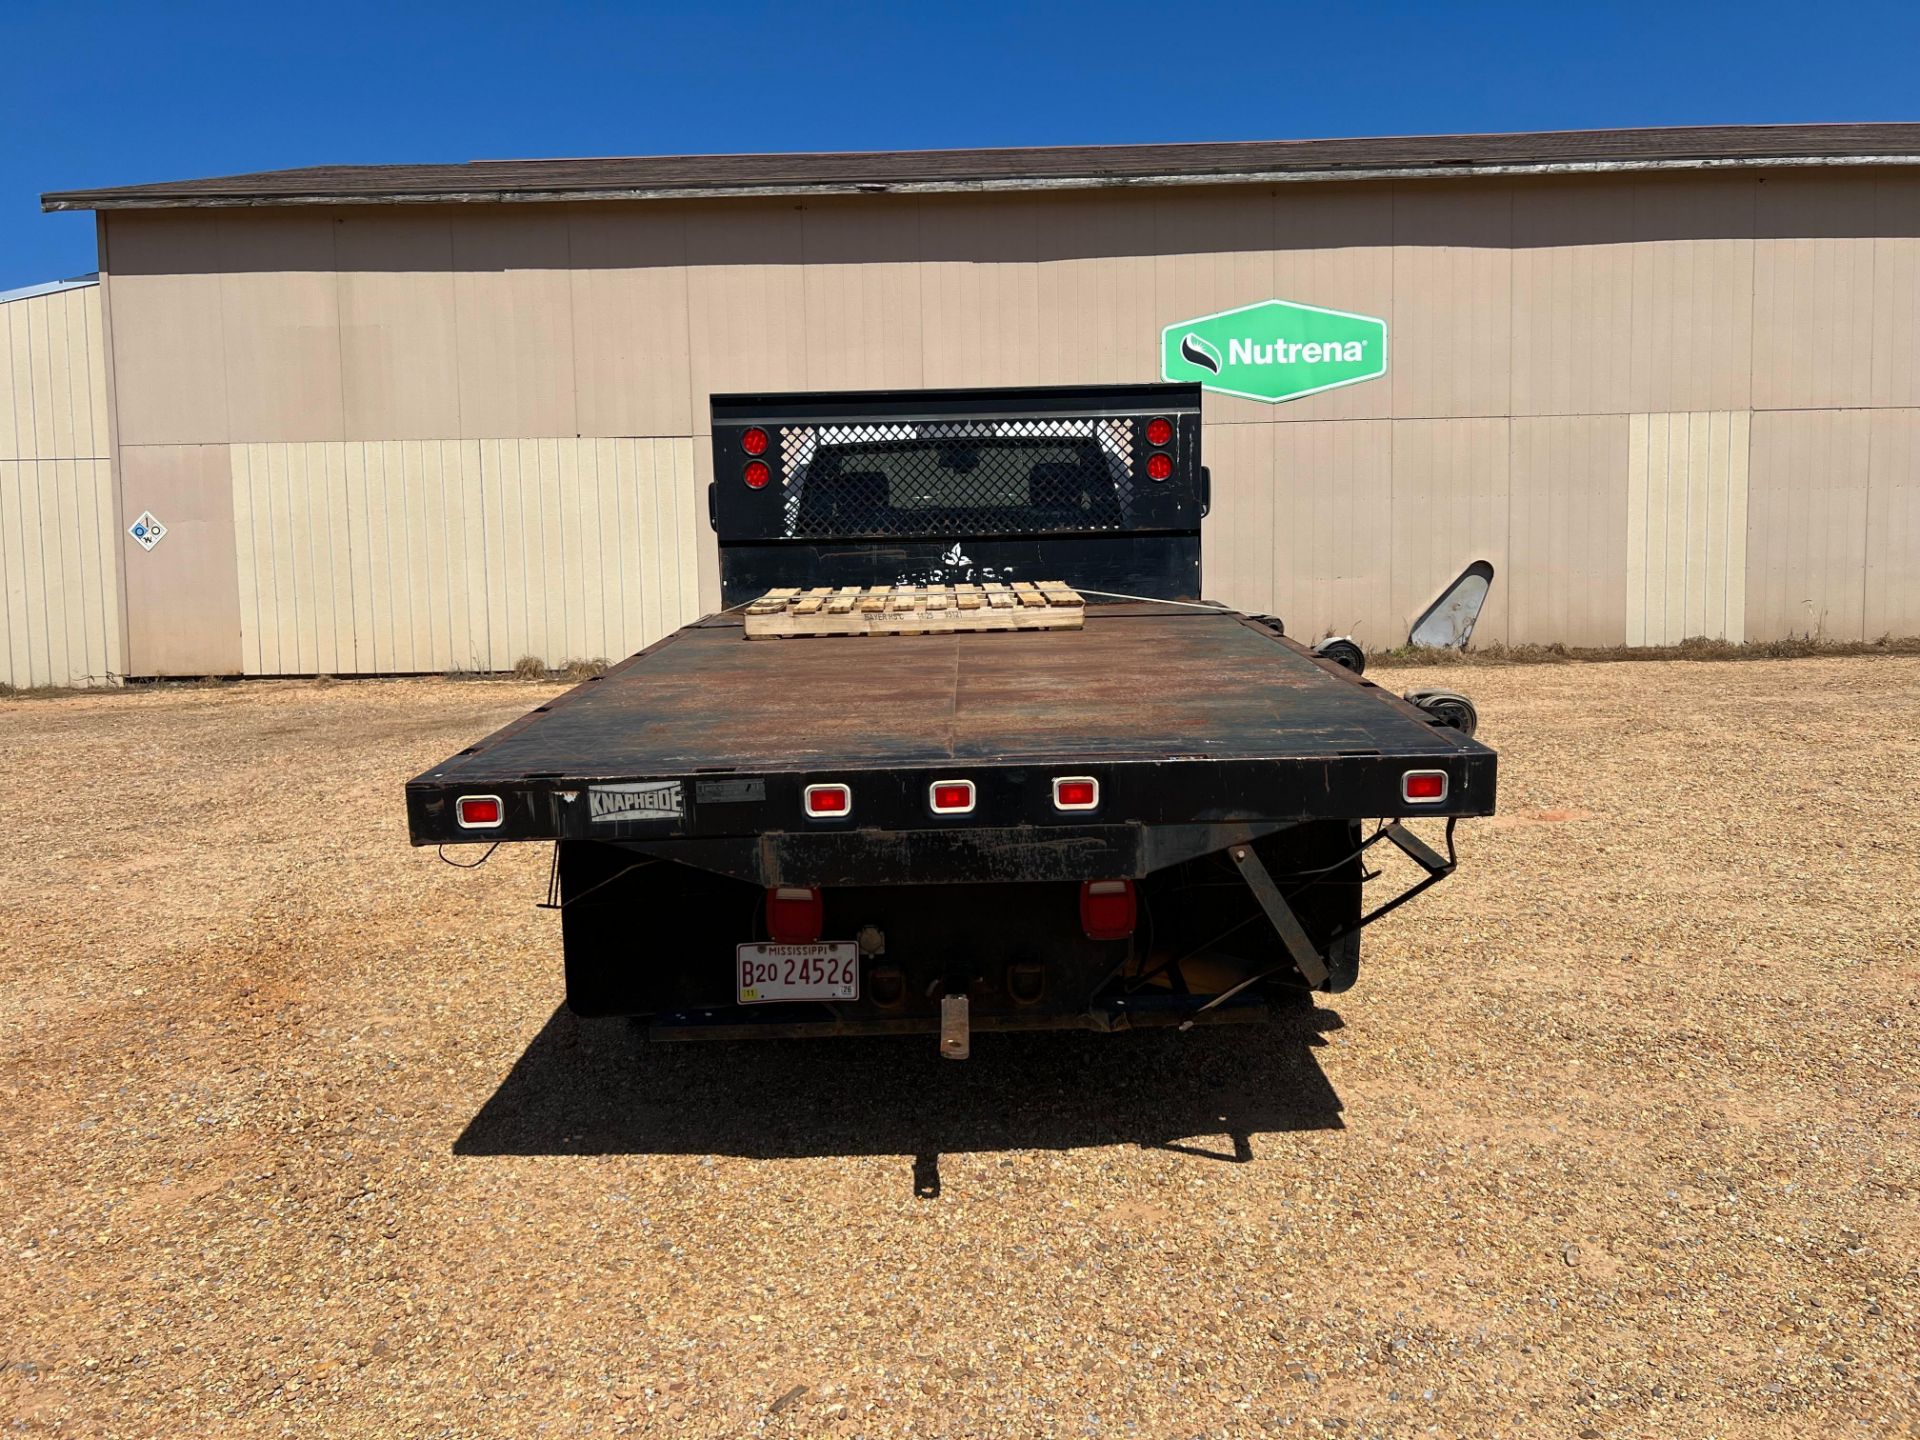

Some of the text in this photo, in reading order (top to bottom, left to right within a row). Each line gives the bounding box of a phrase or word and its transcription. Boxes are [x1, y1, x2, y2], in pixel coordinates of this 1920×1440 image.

[1229, 338, 1363, 365] Nutrena
[589, 785, 683, 816] KNAPHEIDE
[768, 946, 828, 956] MISSISSIPPI
[742, 958, 854, 988] B20 24526
